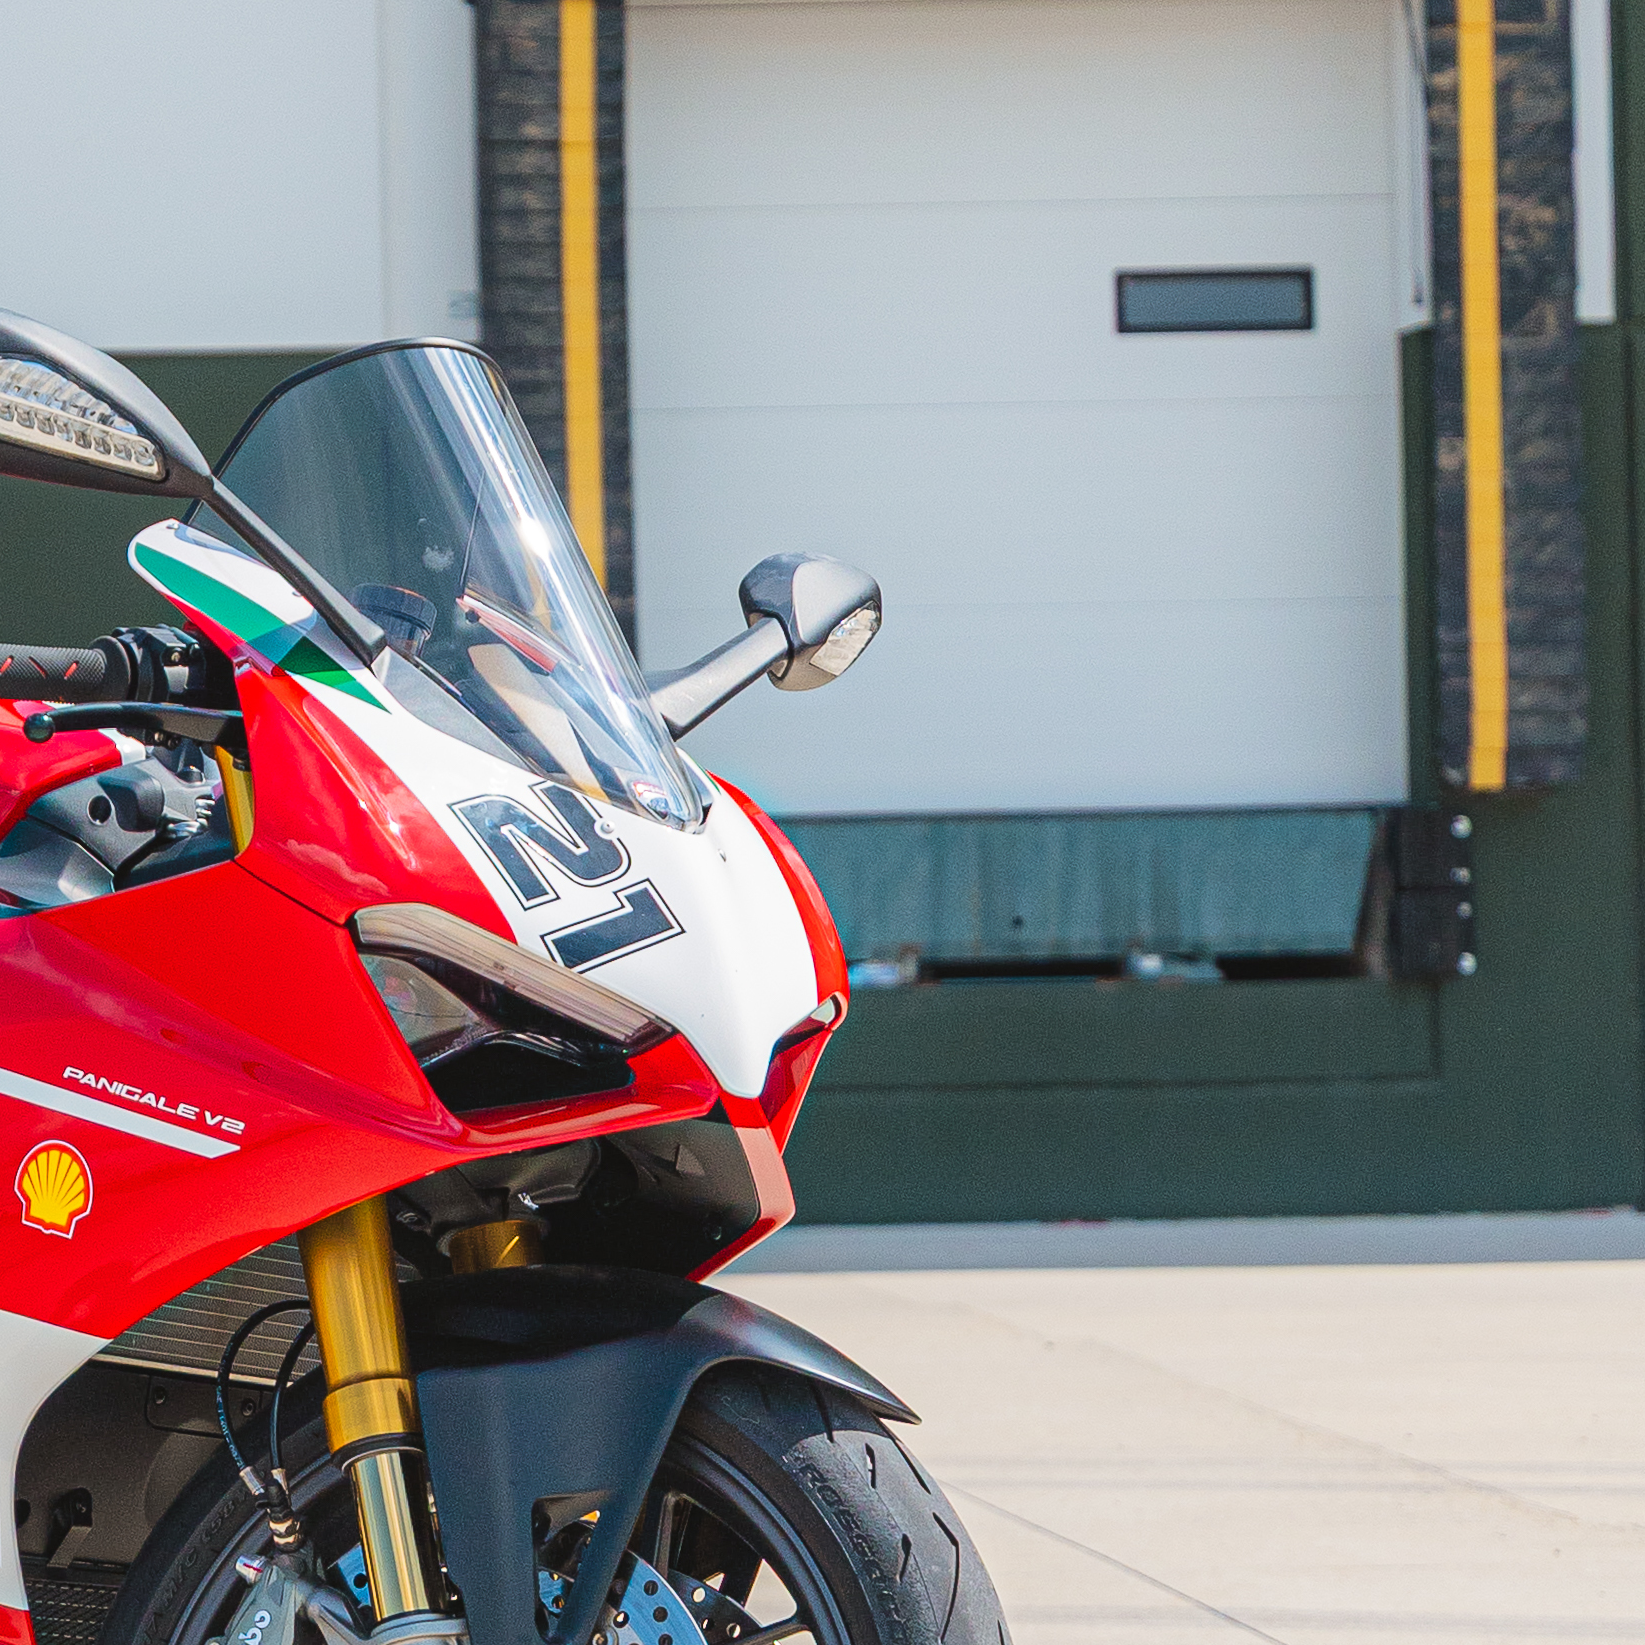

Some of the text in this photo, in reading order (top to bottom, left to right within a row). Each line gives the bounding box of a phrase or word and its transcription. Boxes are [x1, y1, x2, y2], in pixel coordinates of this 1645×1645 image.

[446, 780, 686, 975] 21
[63, 1066, 246, 1135] PANIGALE V2
